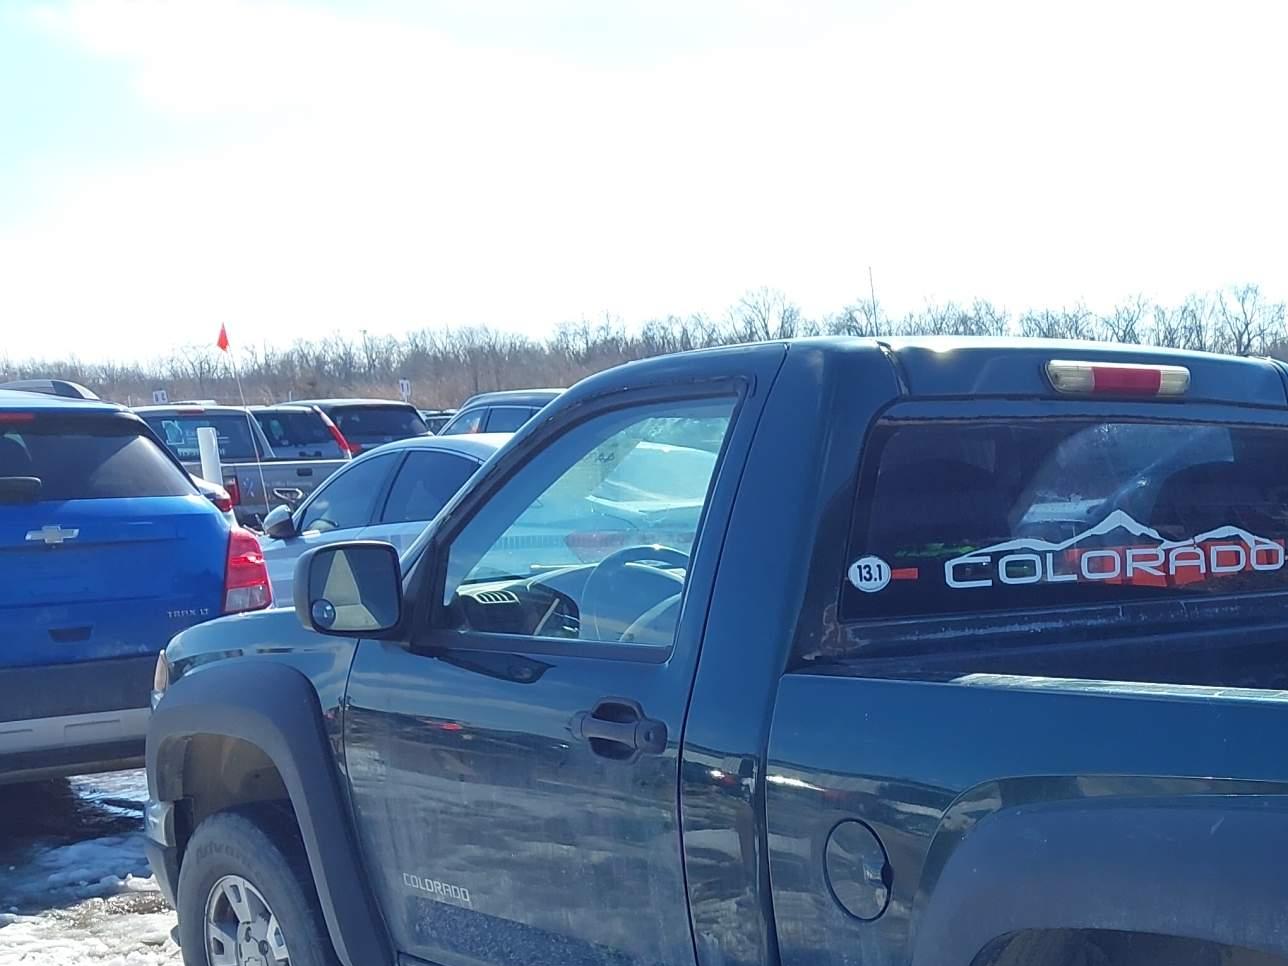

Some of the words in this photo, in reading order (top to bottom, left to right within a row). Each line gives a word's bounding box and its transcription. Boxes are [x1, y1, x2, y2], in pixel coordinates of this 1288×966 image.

[857, 564, 883, 582] 13.1
[945, 541, 1285, 588] COLORADO
[403, 872, 471, 901] COLORADO
